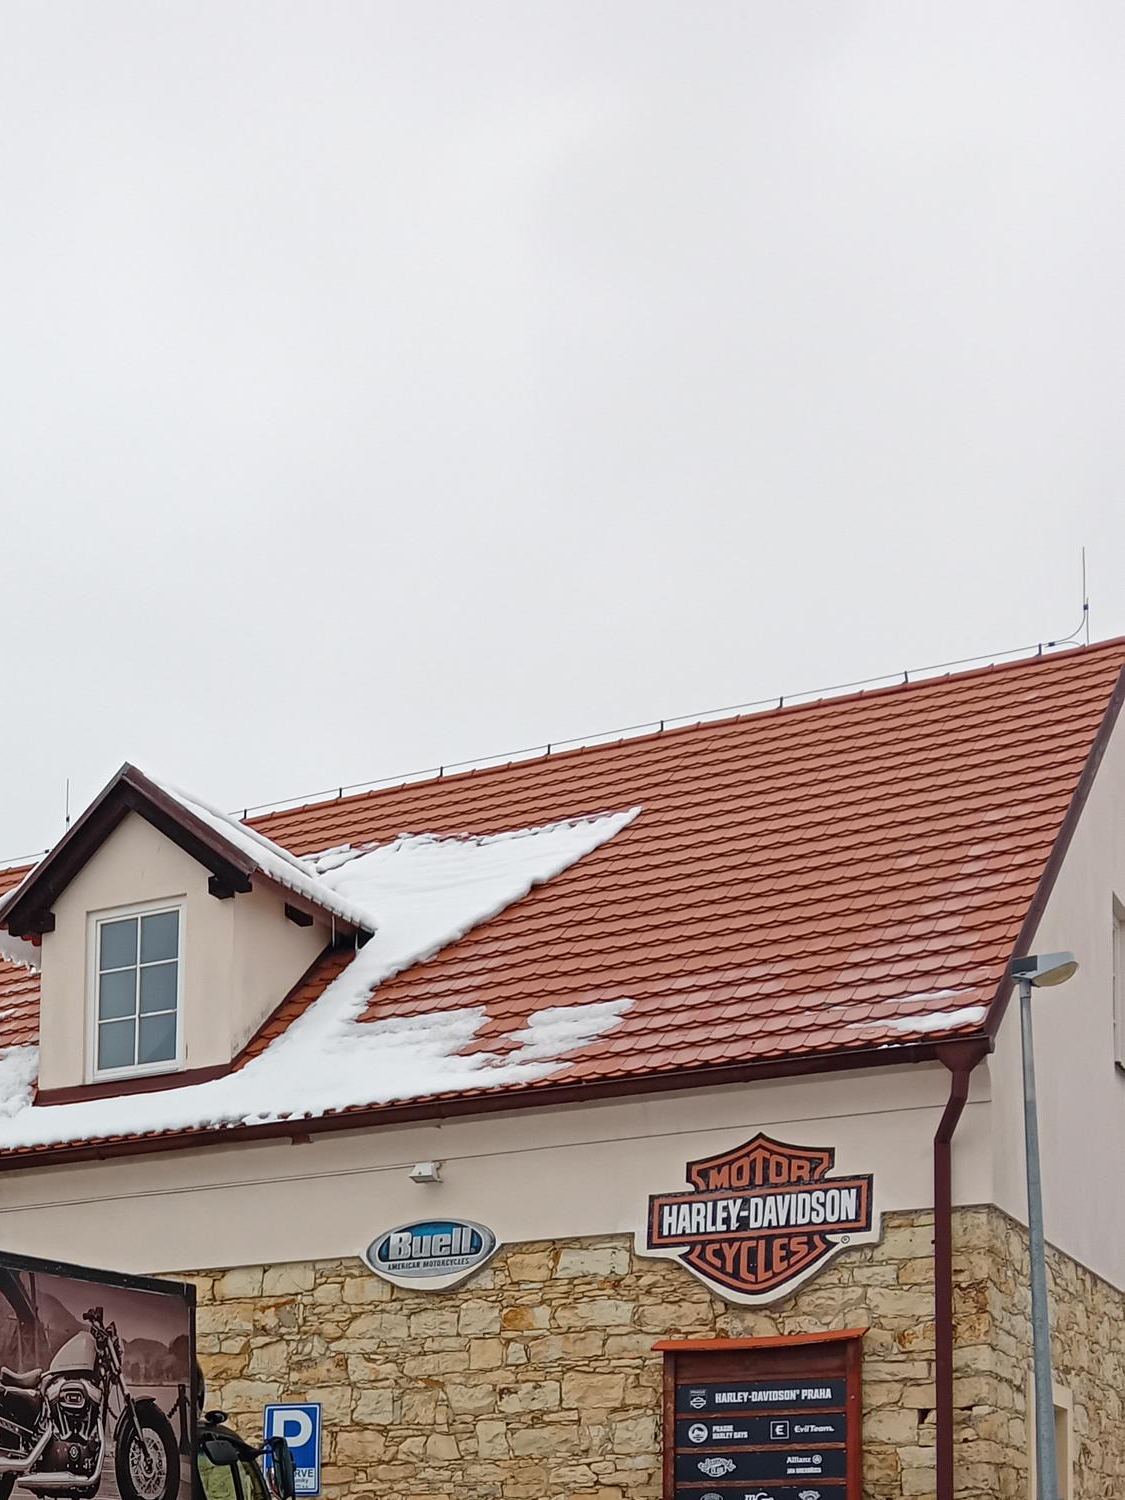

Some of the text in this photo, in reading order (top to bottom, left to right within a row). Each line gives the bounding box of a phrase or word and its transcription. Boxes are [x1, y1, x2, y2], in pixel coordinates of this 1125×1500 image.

[708, 1149, 812, 1191] MOTOR
[662, 1188, 857, 1236] HARLEY-DAVIDSON
[389, 1227, 473, 1260] Buell
[705, 1235, 809, 1283] CYCLES
[388, 1258, 469, 1270] AMERICAN MOTORCYCLES
[801, 1388, 832, 1401] PRAHA
[786, 1456, 812, 1464] Allianz
